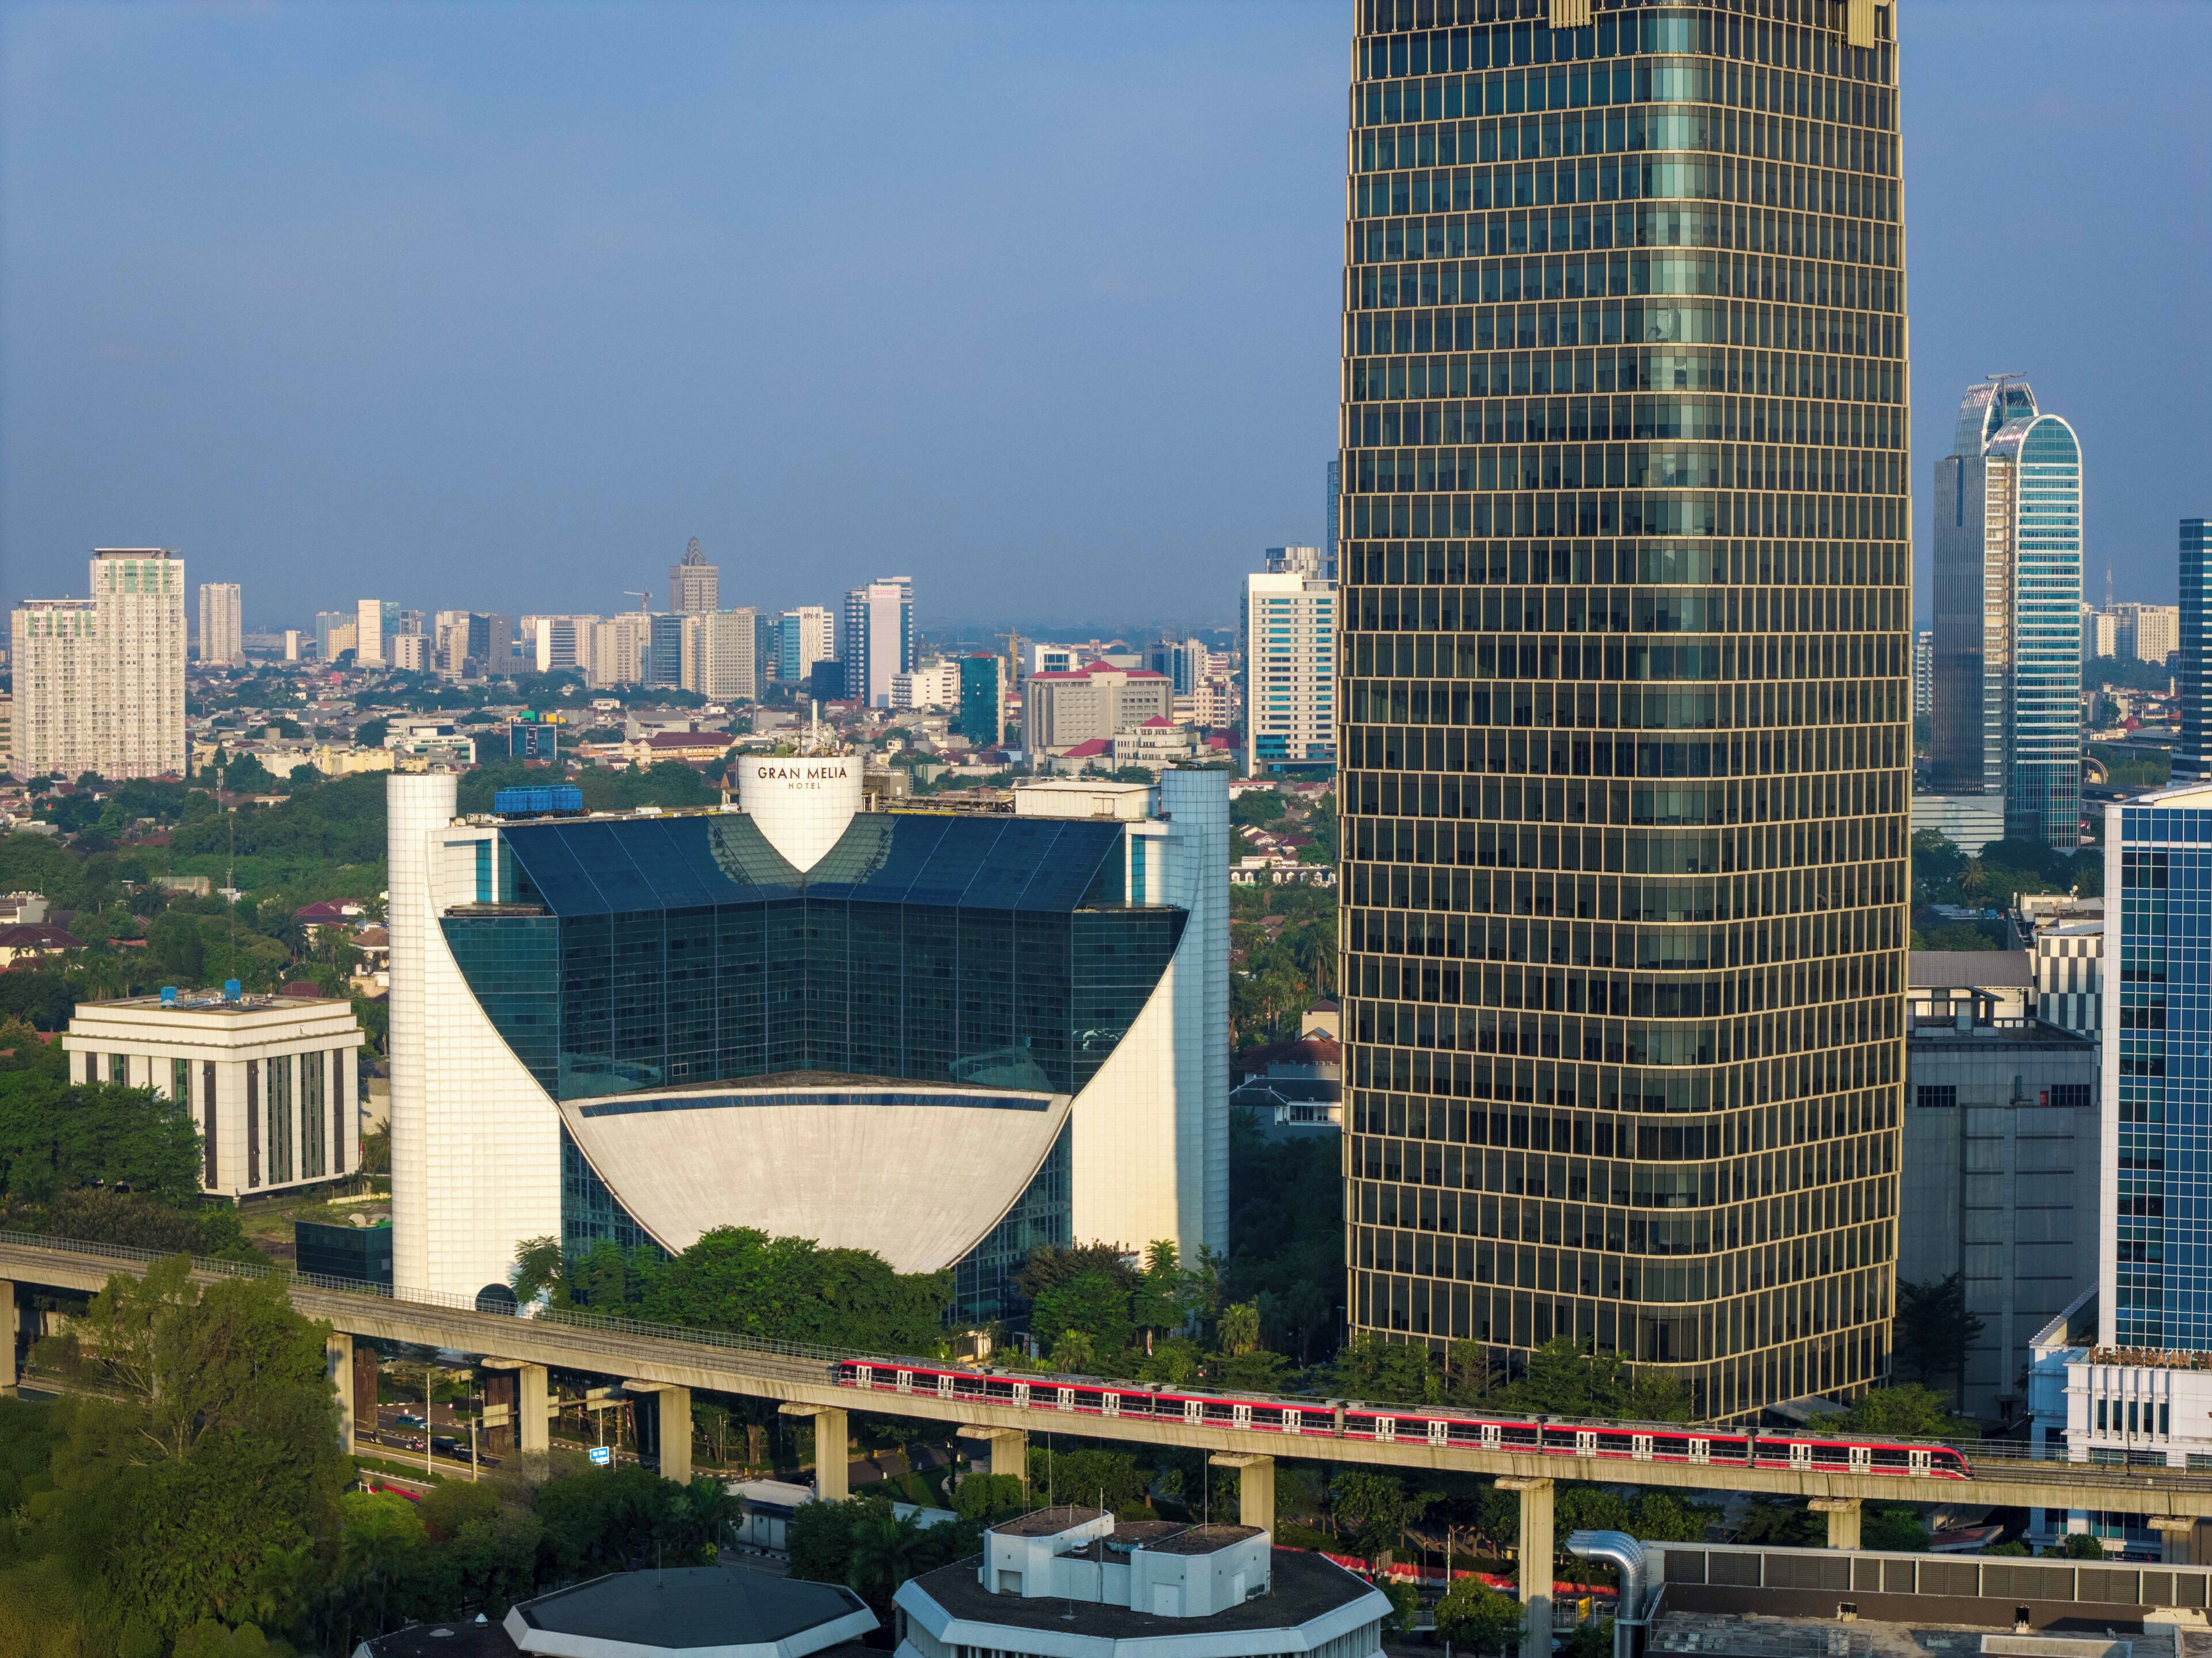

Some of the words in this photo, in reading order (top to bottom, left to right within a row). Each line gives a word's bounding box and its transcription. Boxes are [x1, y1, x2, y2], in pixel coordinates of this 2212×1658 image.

[758, 767, 800, 779] GRAN
[807, 767, 847, 779] MELIA
[2089, 1345, 2191, 1368] KEJAKSAAN
